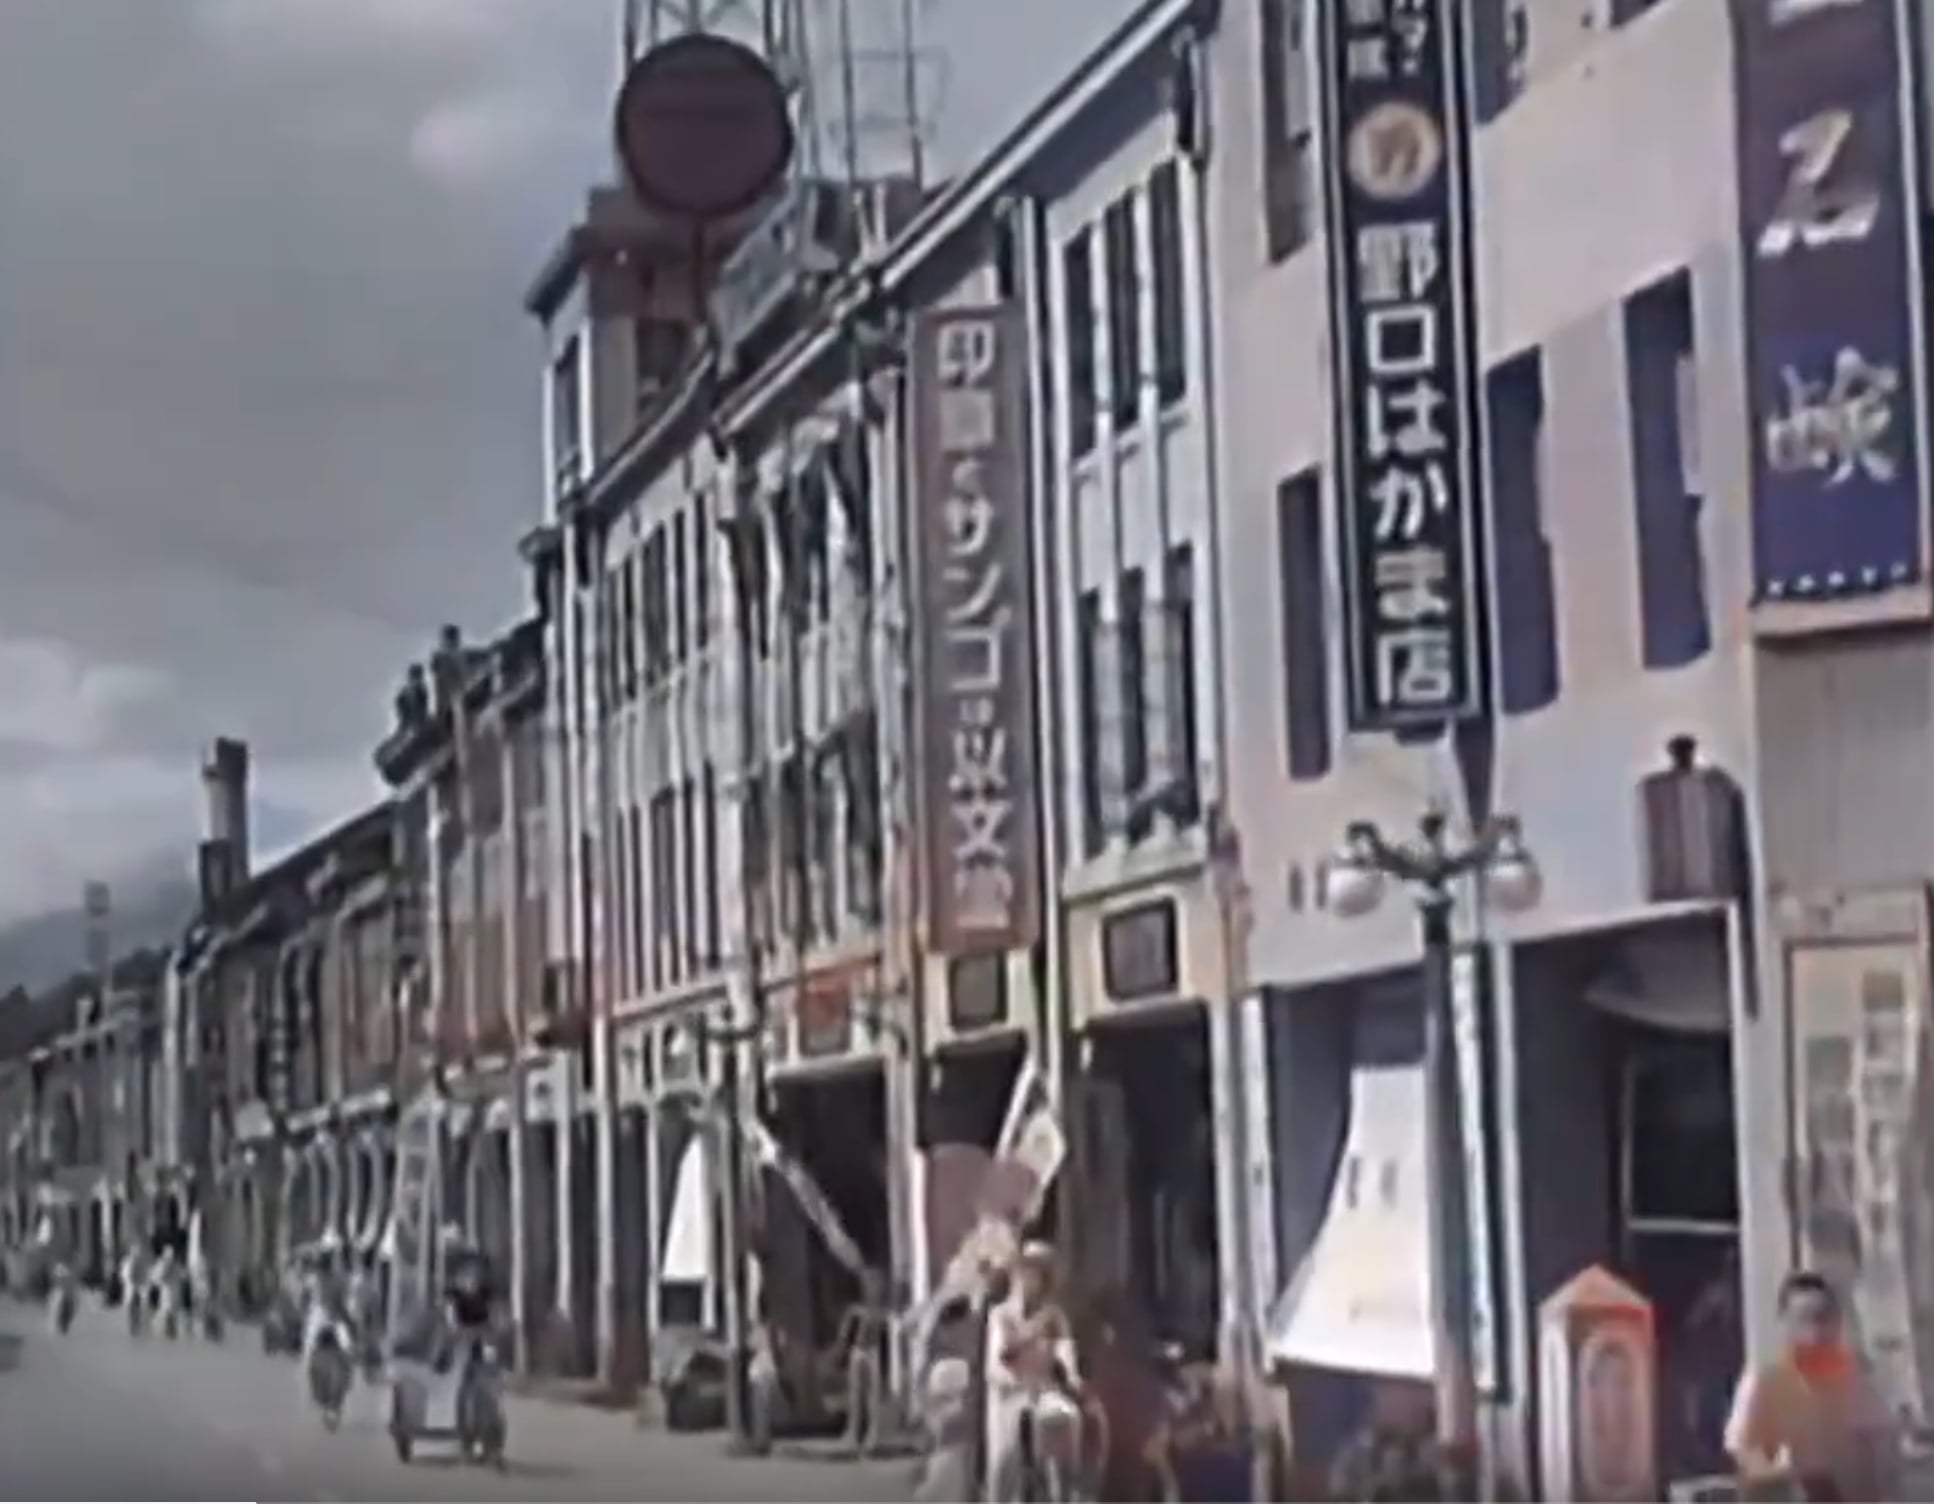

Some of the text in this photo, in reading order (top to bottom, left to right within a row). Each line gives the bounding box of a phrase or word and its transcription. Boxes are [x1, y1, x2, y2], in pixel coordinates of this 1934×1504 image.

[1357, 221, 1453, 706] 野口はかま店
